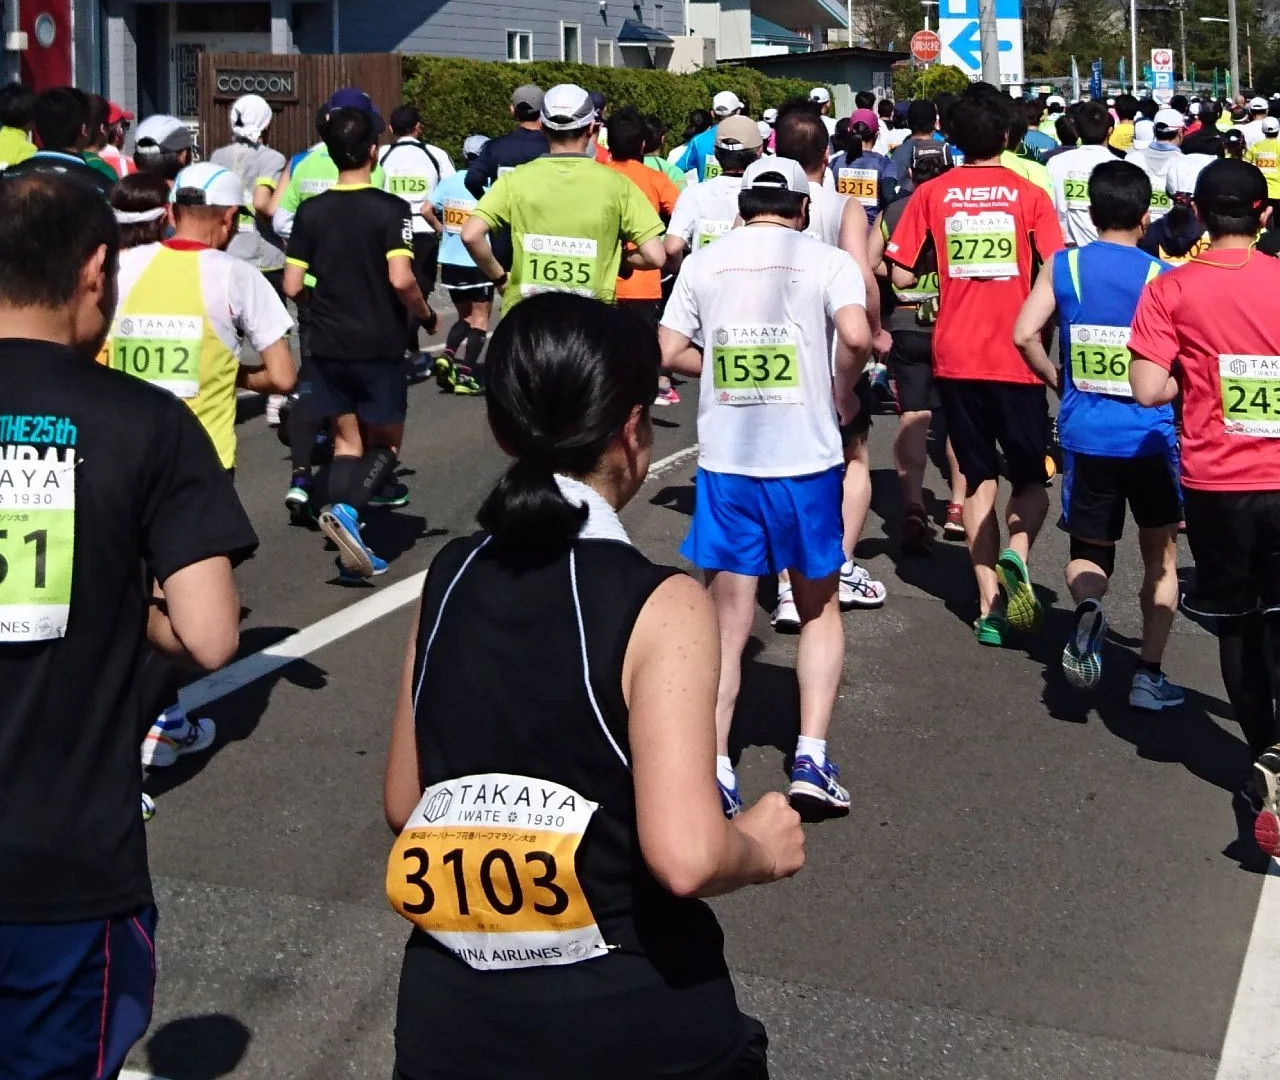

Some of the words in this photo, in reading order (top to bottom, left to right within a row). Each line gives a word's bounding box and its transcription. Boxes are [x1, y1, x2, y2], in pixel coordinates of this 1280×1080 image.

[217, 76, 291, 92] COCOON
[391, 179, 426, 192] 1125
[841, 181, 874, 195] 3215
[943, 186, 1019, 202] AISIN
[548, 239, 592, 249] TAKAYA
[951, 238, 1012, 260] 2729
[529, 259, 590, 284] 1635
[139, 320, 195, 329] TAKAYA
[732, 328, 789, 337] TAKAYA
[119, 346, 189, 374] 1012
[717, 354, 792, 382] 1532
[1077, 351, 1126, 376] 136
[14, 494, 53, 505] 1930
[459, 784, 576, 812] TAKAYA
[458, 810, 500, 822] IWATE
[526, 813, 565, 827] 1930
[402, 847, 569, 916] 3103
[492, 947, 562, 962] AIRLINES
